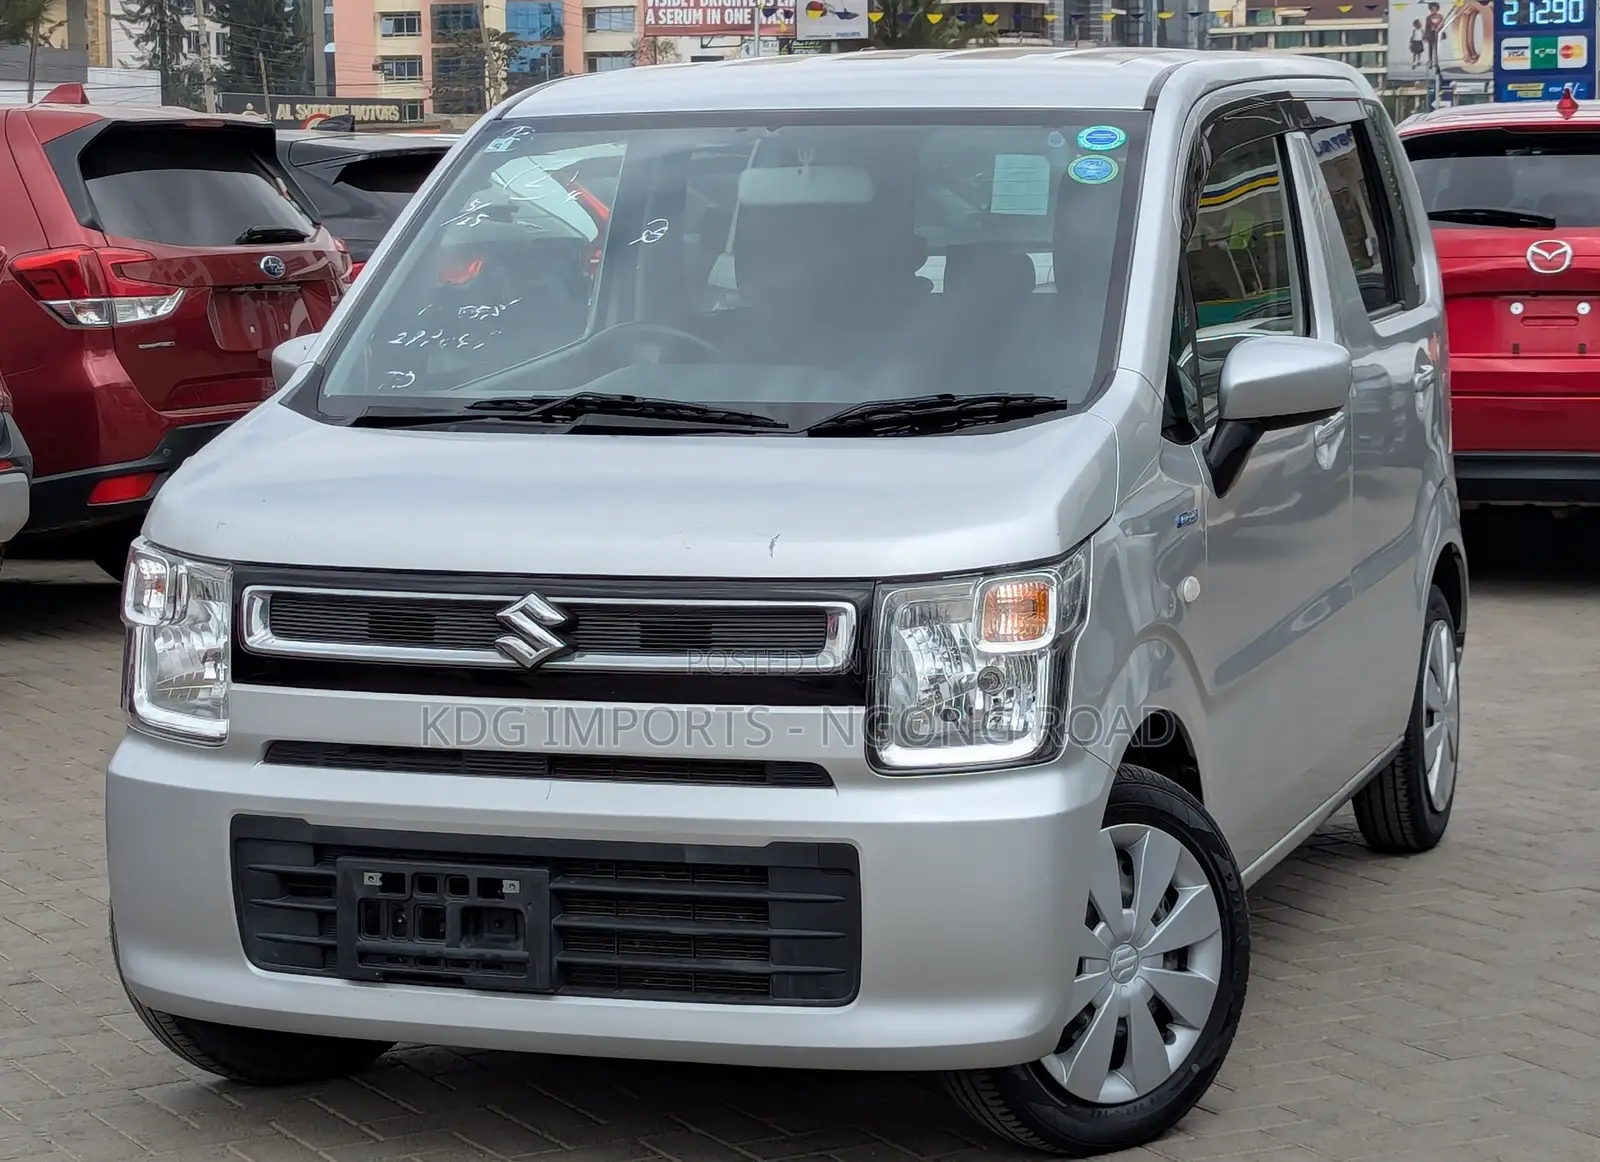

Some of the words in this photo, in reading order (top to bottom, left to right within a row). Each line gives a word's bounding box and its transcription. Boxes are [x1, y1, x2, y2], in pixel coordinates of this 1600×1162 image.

[645, 8, 656, 25] A
[658, 8, 703, 25] SERUM
[706, 8, 720, 25] IN
[724, 8, 752, 25] ONE
[275, 103, 294, 120] AL
